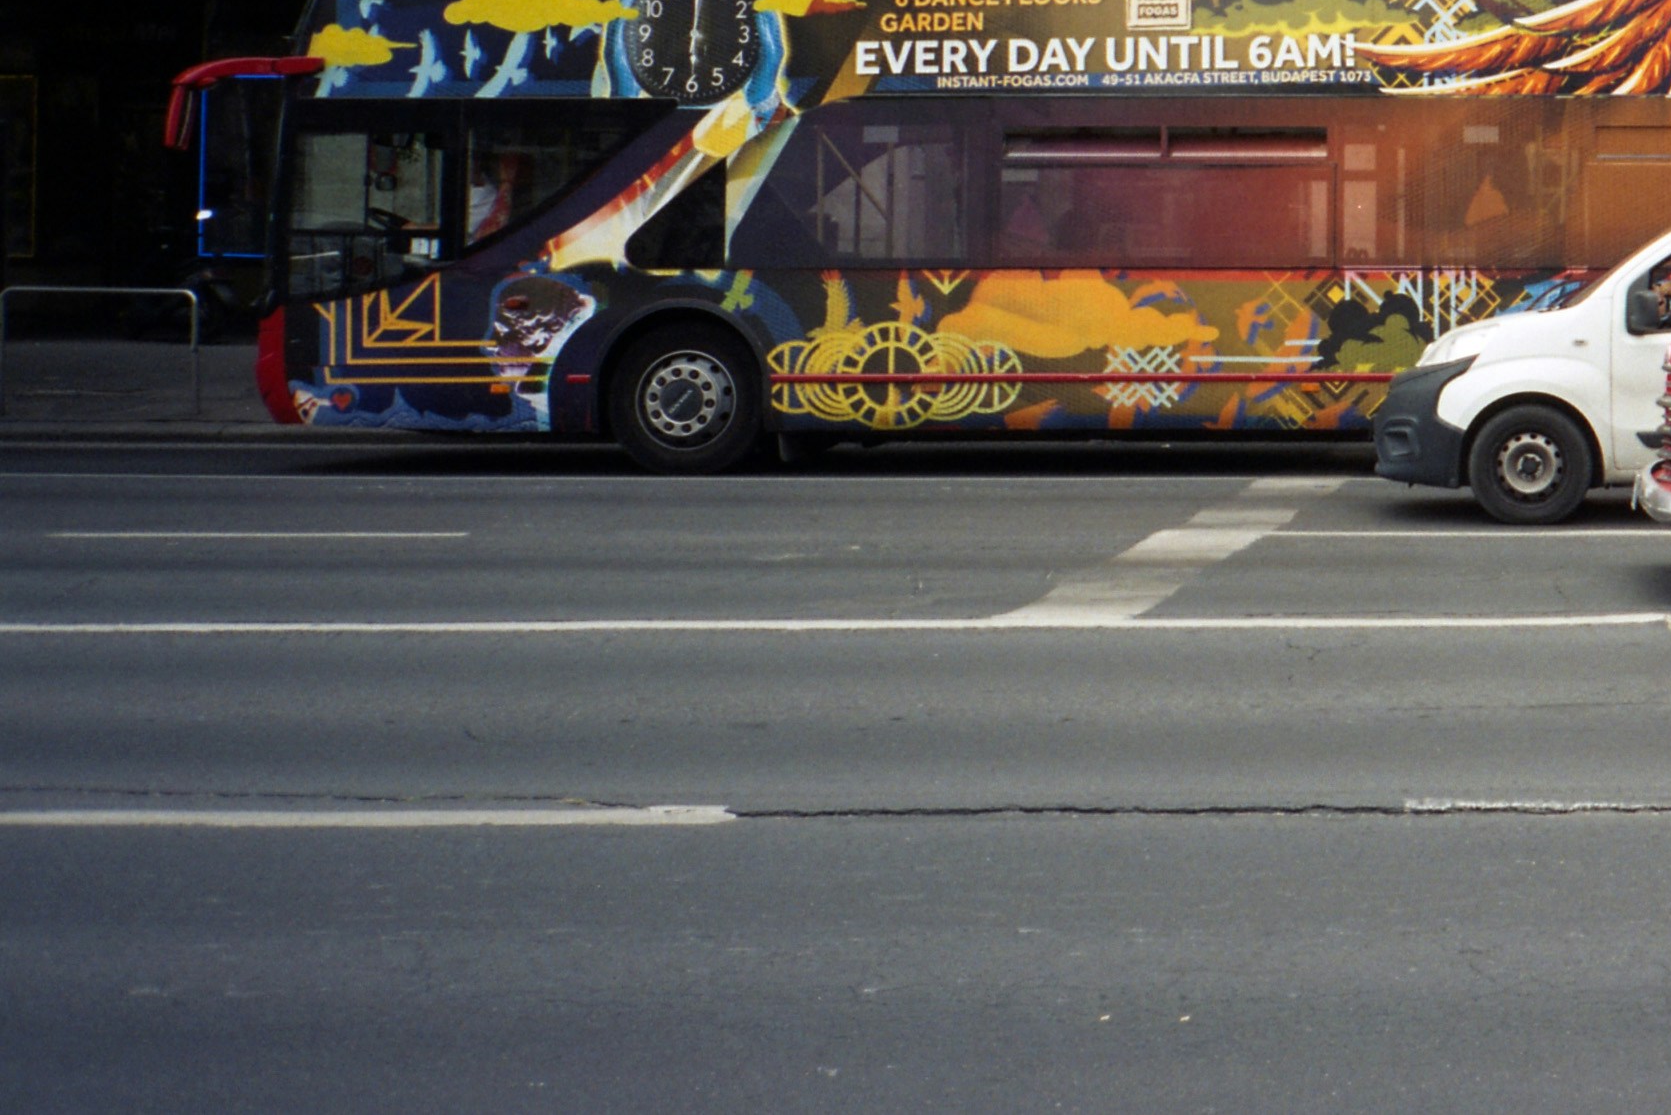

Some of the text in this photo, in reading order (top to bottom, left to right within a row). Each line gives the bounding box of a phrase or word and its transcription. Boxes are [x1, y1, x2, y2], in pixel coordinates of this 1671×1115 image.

[645, 0, 663, 18] 10
[735, 0, 747, 19] 2
[1139, 5, 1177, 17] FOGAS
[880, 12, 984, 33] GARDEN
[638, 24, 652, 43] 9
[738, 25, 750, 44] 3
[641, 49, 654, 67] 8
[731, 50, 744, 67] 4
[855, 33, 1355, 75] EVERY DAY UNTIL 6AM!
[661, 67, 675, 86] 7
[685, 74, 698, 93] 6
[711, 67, 724, 86] 5
[937, 70, 1372, 89] INSTANT-FOGAS.COM 49-51 AKACFA STREET, BUDAPEST 1073
